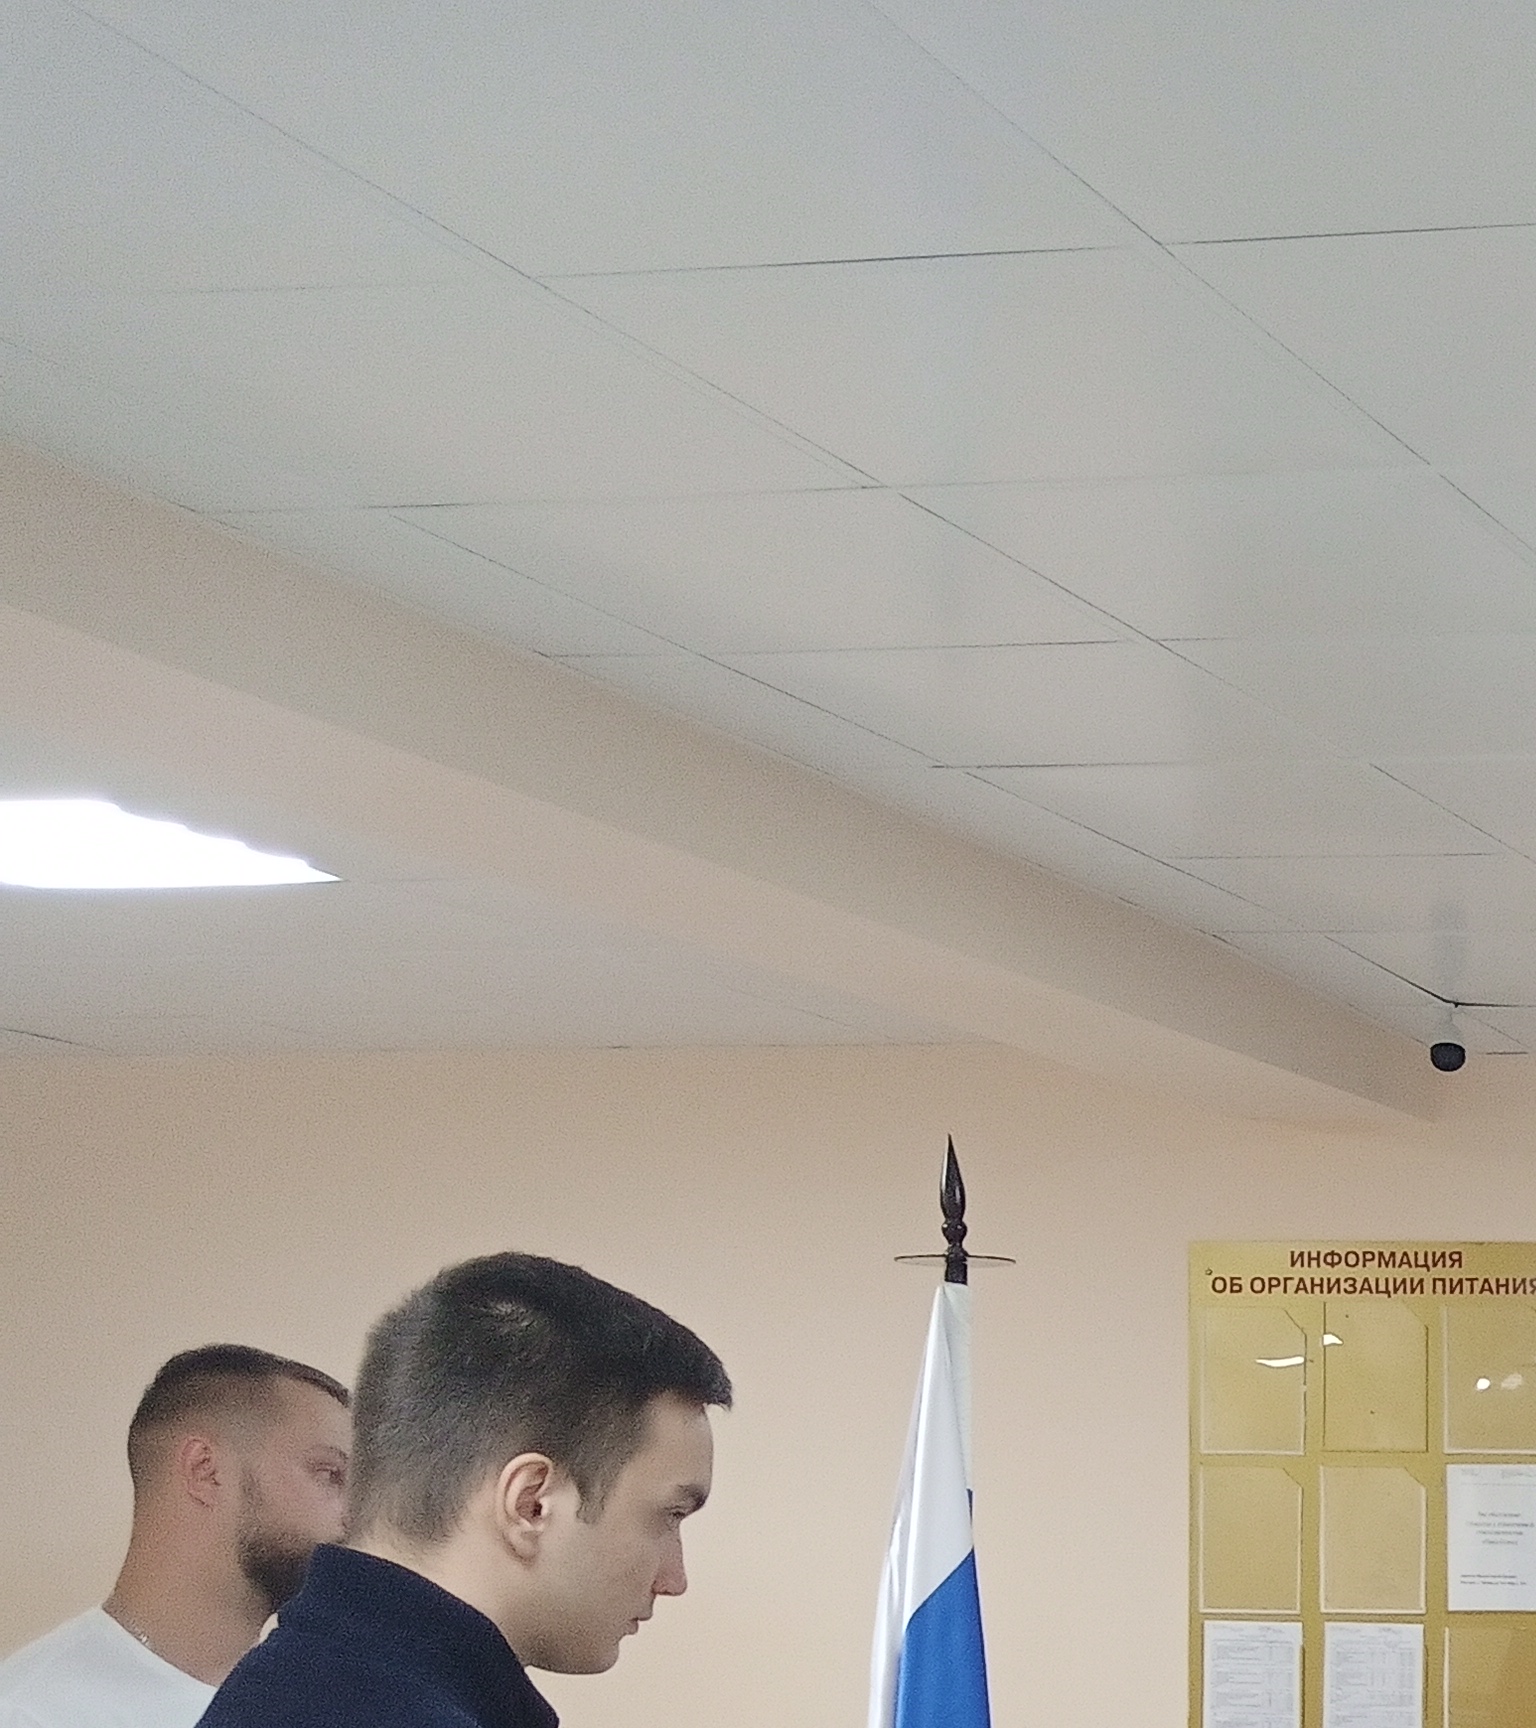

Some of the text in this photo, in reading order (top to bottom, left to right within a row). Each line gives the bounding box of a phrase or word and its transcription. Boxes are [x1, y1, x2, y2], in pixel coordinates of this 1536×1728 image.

[1290, 1250, 1463, 1272] ИНФОРМАЦИЯ
[1211, 1276, 1243, 1294] ОБ
[1250, 1276, 1425, 1298] ОРГАНИЗАЦИИ
